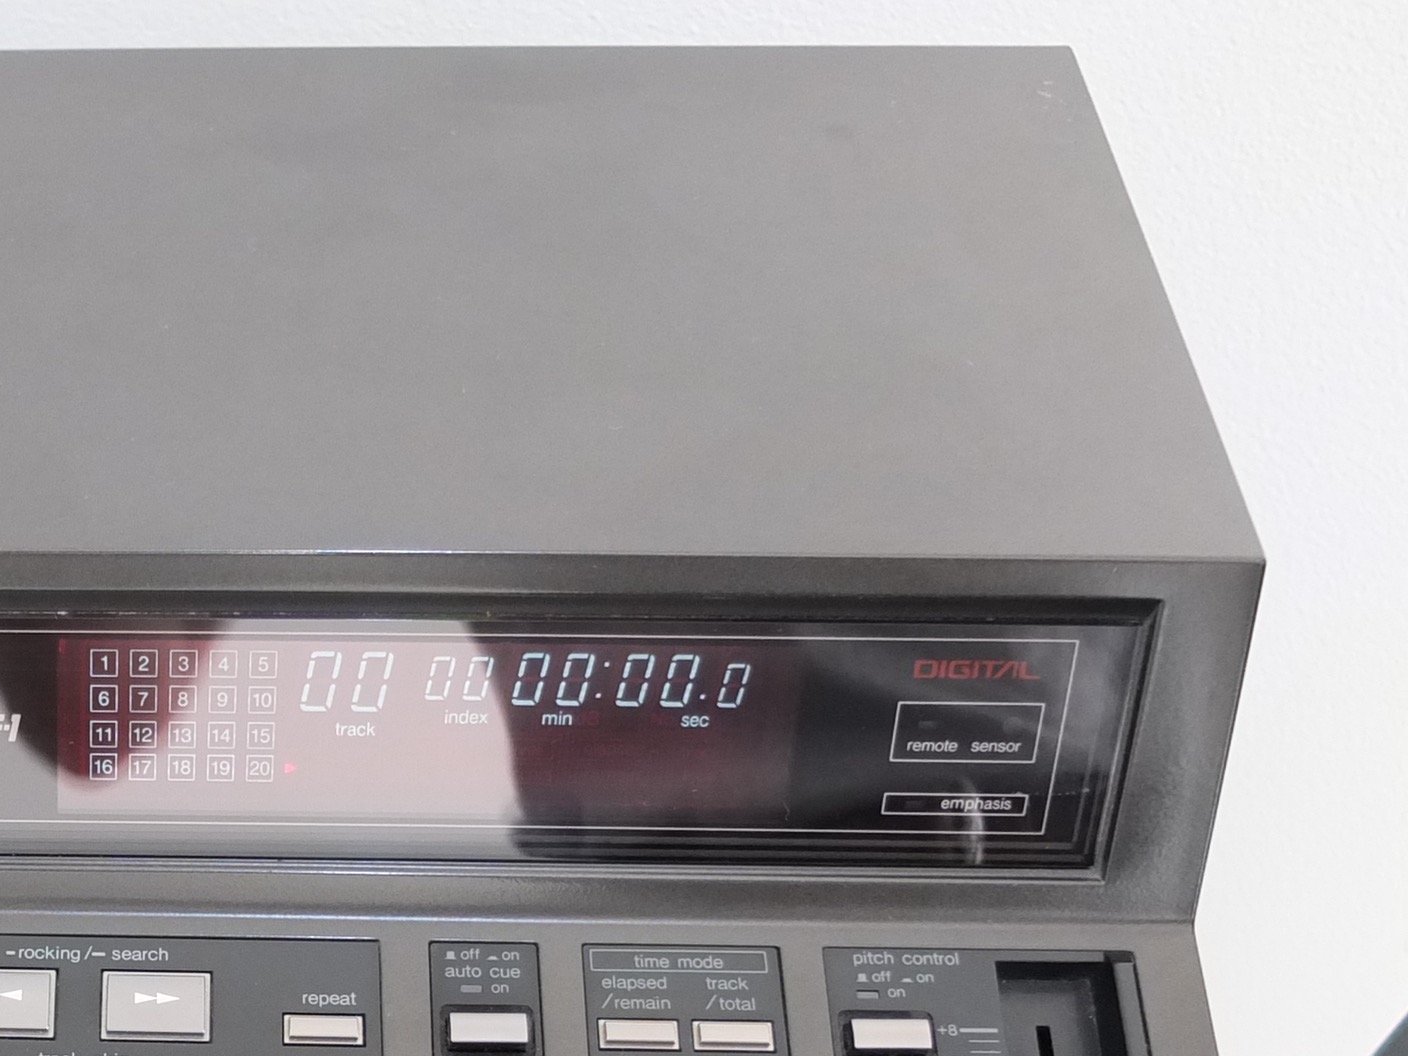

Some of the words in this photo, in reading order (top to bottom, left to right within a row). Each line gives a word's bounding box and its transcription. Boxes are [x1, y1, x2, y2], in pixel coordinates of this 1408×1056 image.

[100, 655, 109, 671] 1
[138, 655, 149, 671] 2
[178, 656, 189, 671] 3
[218, 656, 229, 671] 4
[258, 656, 269, 672] 5
[913, 659, 1040, 679] DIGITAL
[299, 650, 393, 713] 00
[424, 656, 494, 701] 00
[99, 692, 109, 707] 6
[138, 692, 148, 707] 7
[178, 692, 188, 707] 8
[217, 692, 227, 707] 9
[253, 693, 271, 708] 10
[445, 711, 488, 724] index
[542, 712, 572, 726] min
[681, 714, 709, 727] sec
[96, 728, 113, 742] 11
[134, 728, 152, 742] 12
[173, 728, 191, 742] 13
[212, 728, 230, 742] 14
[252, 729, 270, 742] 15
[335, 722, 376, 736] track
[906, 739, 958, 752] remote
[971, 740, 1021, 752] sensor
[94, 760, 112, 773] 16
[133, 760, 151, 773] 17
[172, 761, 190, 774] 18
[211, 762, 230, 775] 19
[250, 762, 270, 775] 20
[941, 798, 1012, 812] emphasis
[112, 948, 168, 961] search
[461, 949, 480, 961] off
[502, 951, 519, 960] on
[853, 951, 894, 966] pitch
[902, 953, 959, 965] control
[634, 956, 669, 968] time
[678, 956, 723, 969] mode
[445, 966, 481, 978] auto
[490, 967, 520, 978] cue
[872, 971, 891, 982] off
[916, 973, 934, 982] on
[491, 983, 509, 994] on
[601, 977, 667, 992] elapsed
[706, 978, 749, 990] track
[302, 991, 356, 1008] repeat
[888, 988, 906, 997] on
[601, 993, 671, 1010] /remain
[706, 994, 756, 1011] /total
[937, 1025, 958, 1036] +8
